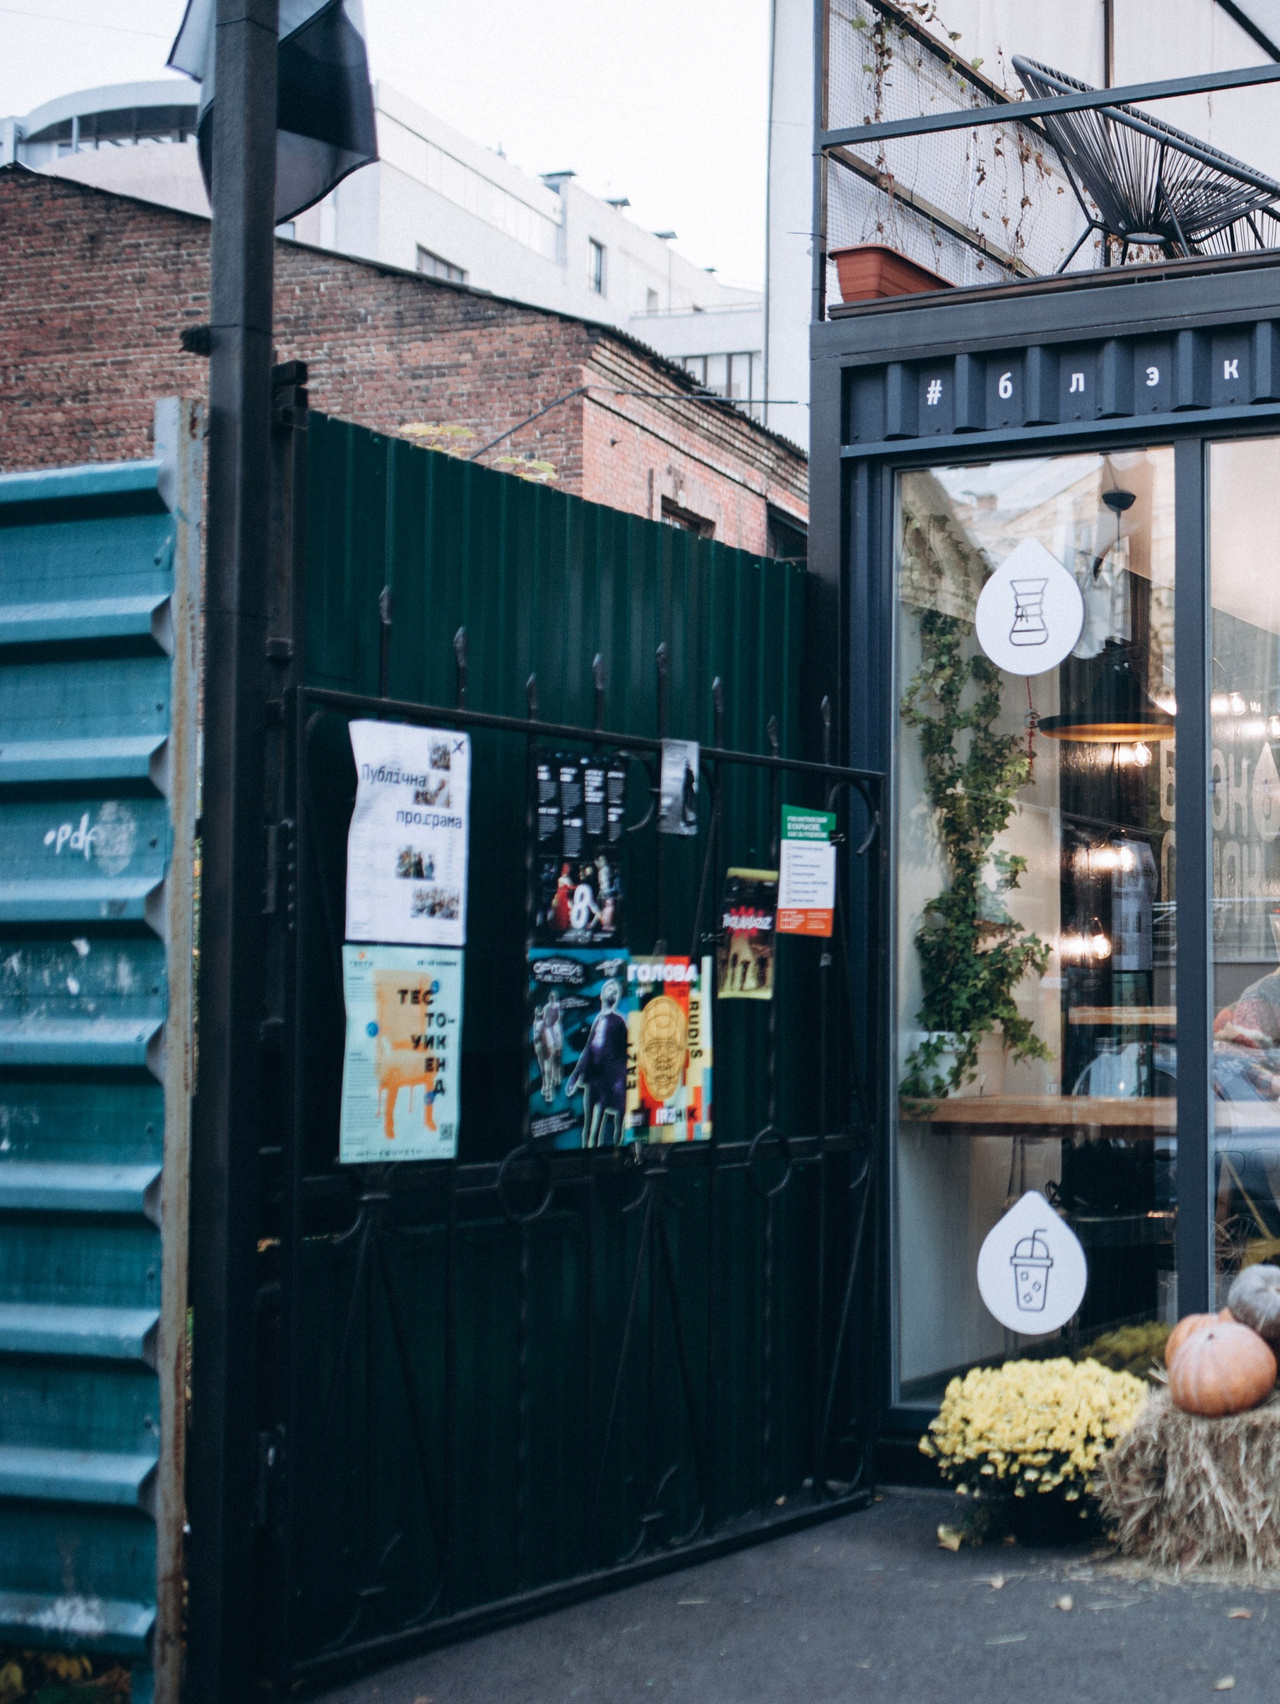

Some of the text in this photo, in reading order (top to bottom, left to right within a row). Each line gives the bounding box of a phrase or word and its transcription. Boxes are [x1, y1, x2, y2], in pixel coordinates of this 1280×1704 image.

[361, 763, 428, 788] Публічна
[570, 883, 594, 929] 8
[627, 964, 698, 982] ГОЛОВА
[397, 989, 435, 1006] ТЕС
[687, 1001, 703, 1060] RUDIS
[425, 1056, 447, 1074] ЕН
[656, 1107, 697, 1125] IRZHIK
